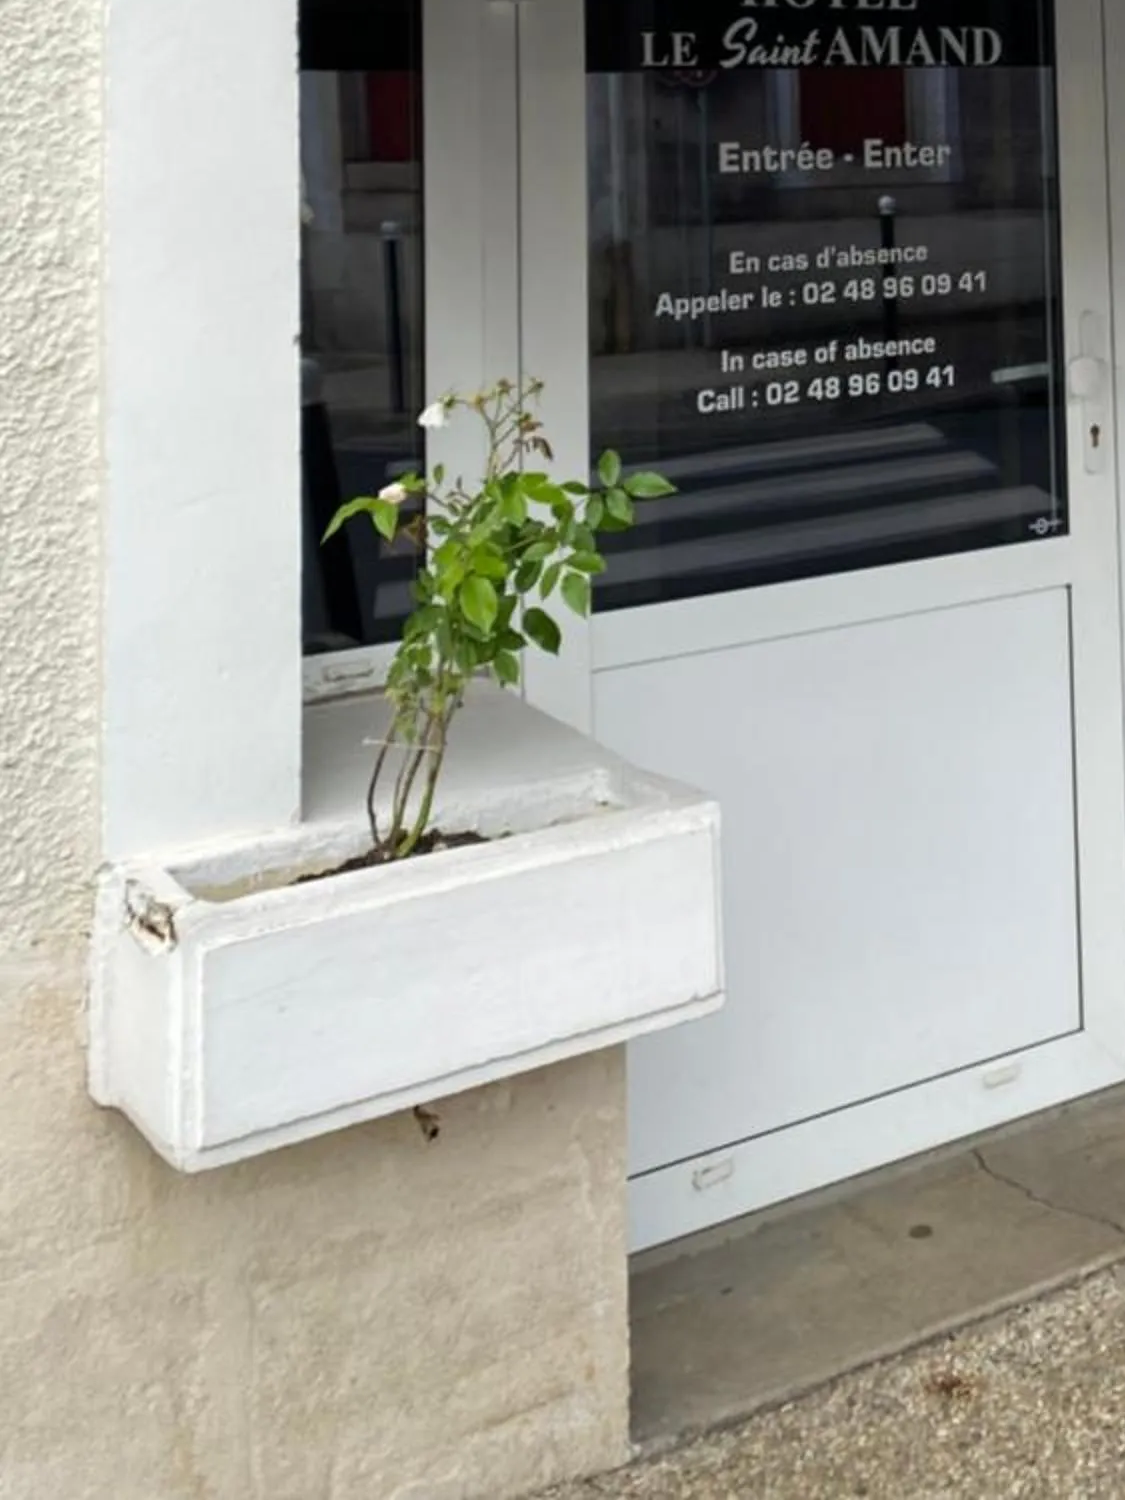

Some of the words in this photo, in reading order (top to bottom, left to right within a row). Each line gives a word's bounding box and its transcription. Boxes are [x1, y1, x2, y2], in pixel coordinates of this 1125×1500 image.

[642, 32, 698, 67] LE
[720, 17, 821, 69] Saint
[824, 26, 1002, 67] AMAND
[718, 140, 834, 173] Entrée
[864, 139, 951, 169] Enter
[730, 250, 759, 274] En
[768, 251, 808, 271] cas
[816, 243, 928, 269] d'absence
[655, 288, 754, 320] Appeler
[761, 286, 782, 308] le
[803, 282, 836, 304] 02
[843, 279, 874, 301] 48
[882, 276, 912, 299] 96
[921, 273, 952, 296] 09
[958, 271, 986, 292] 41
[721, 350, 744, 373] In
[752, 346, 807, 370] case
[815, 341, 837, 364] of
[844, 335, 935, 361] absence
[697, 388, 744, 413] Call
[766, 382, 799, 405] 02
[807, 378, 840, 401] 48
[848, 374, 880, 396] 96
[887, 370, 919, 392] 09
[926, 366, 955, 388] 41
